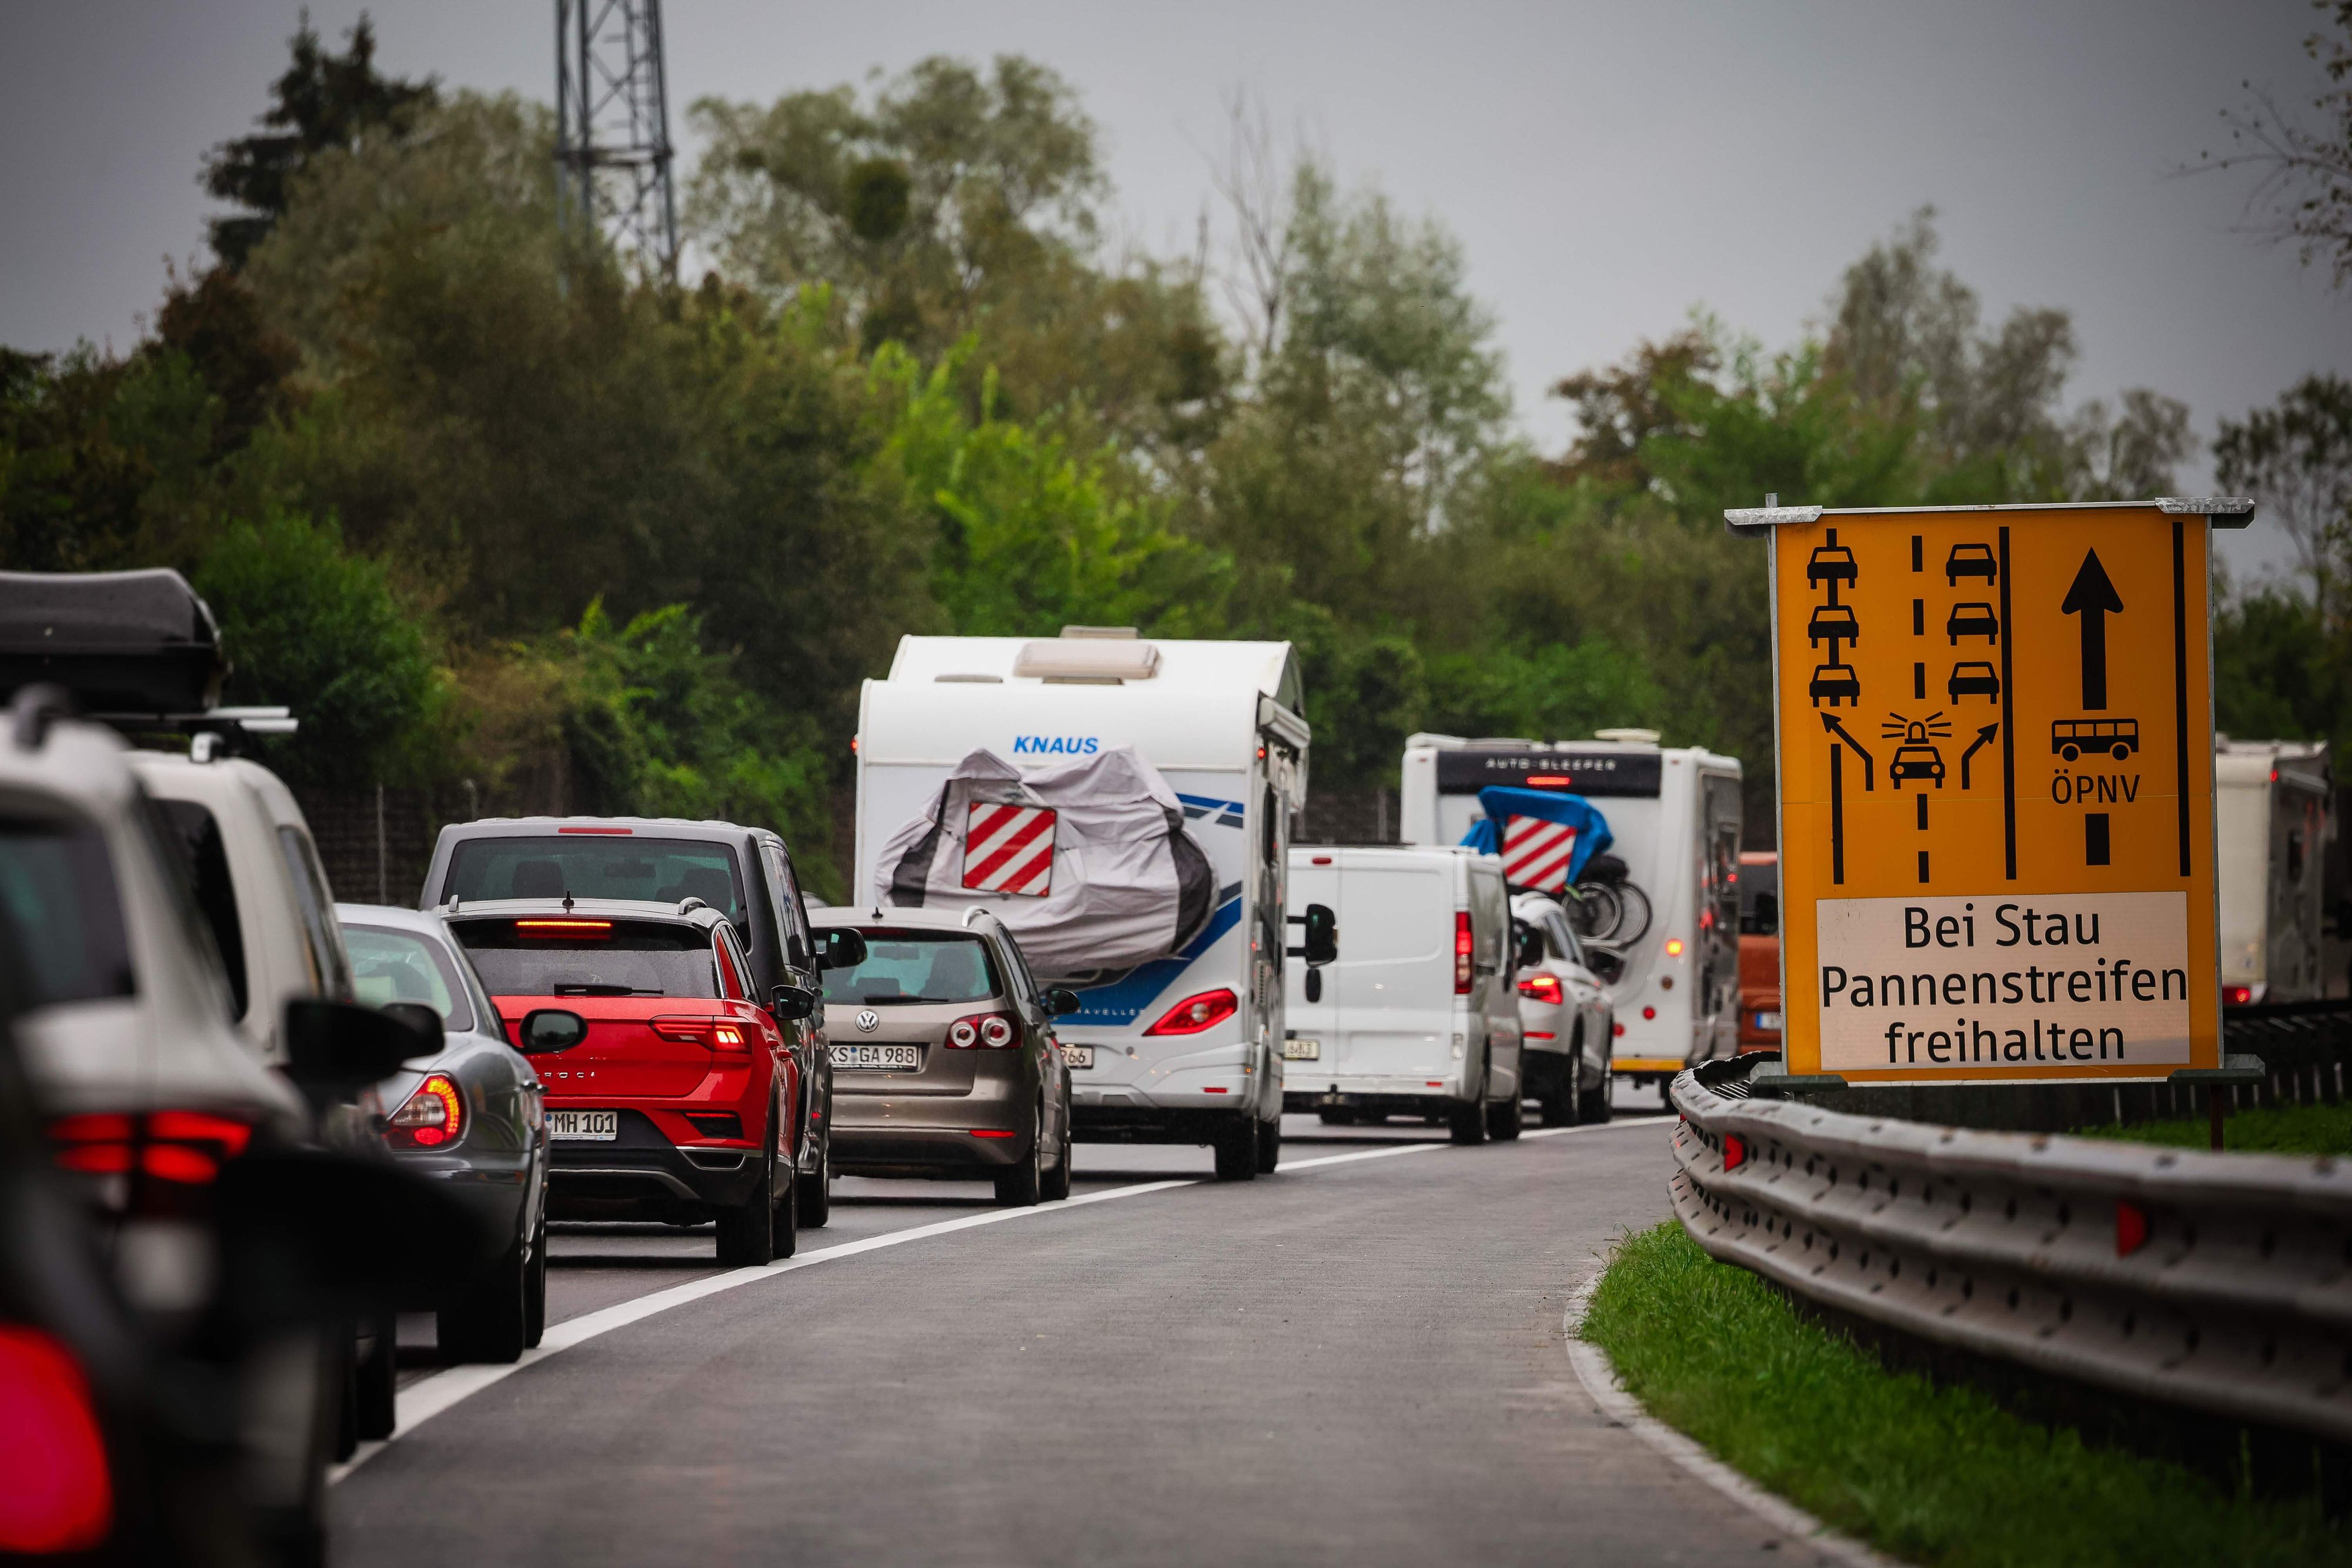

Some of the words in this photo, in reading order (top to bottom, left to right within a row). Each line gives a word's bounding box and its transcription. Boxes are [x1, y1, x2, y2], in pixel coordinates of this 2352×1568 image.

[1014, 736, 1098, 754] KNAUS
[2052, 768, 2141, 804] ÖPNV
[1904, 902, 1975, 948] Bei
[1994, 904, 2100, 947] Stau
[1822, 957, 2187, 1008] Pannenstreifen
[828, 1047, 848, 1062] KS
[860, 1047, 880, 1062] GA
[885, 1048, 914, 1064] 988
[1884, 1018, 2124, 1064] freihalten
[554, 1114, 578, 1133] MH
[582, 1114, 616, 1134] 101
